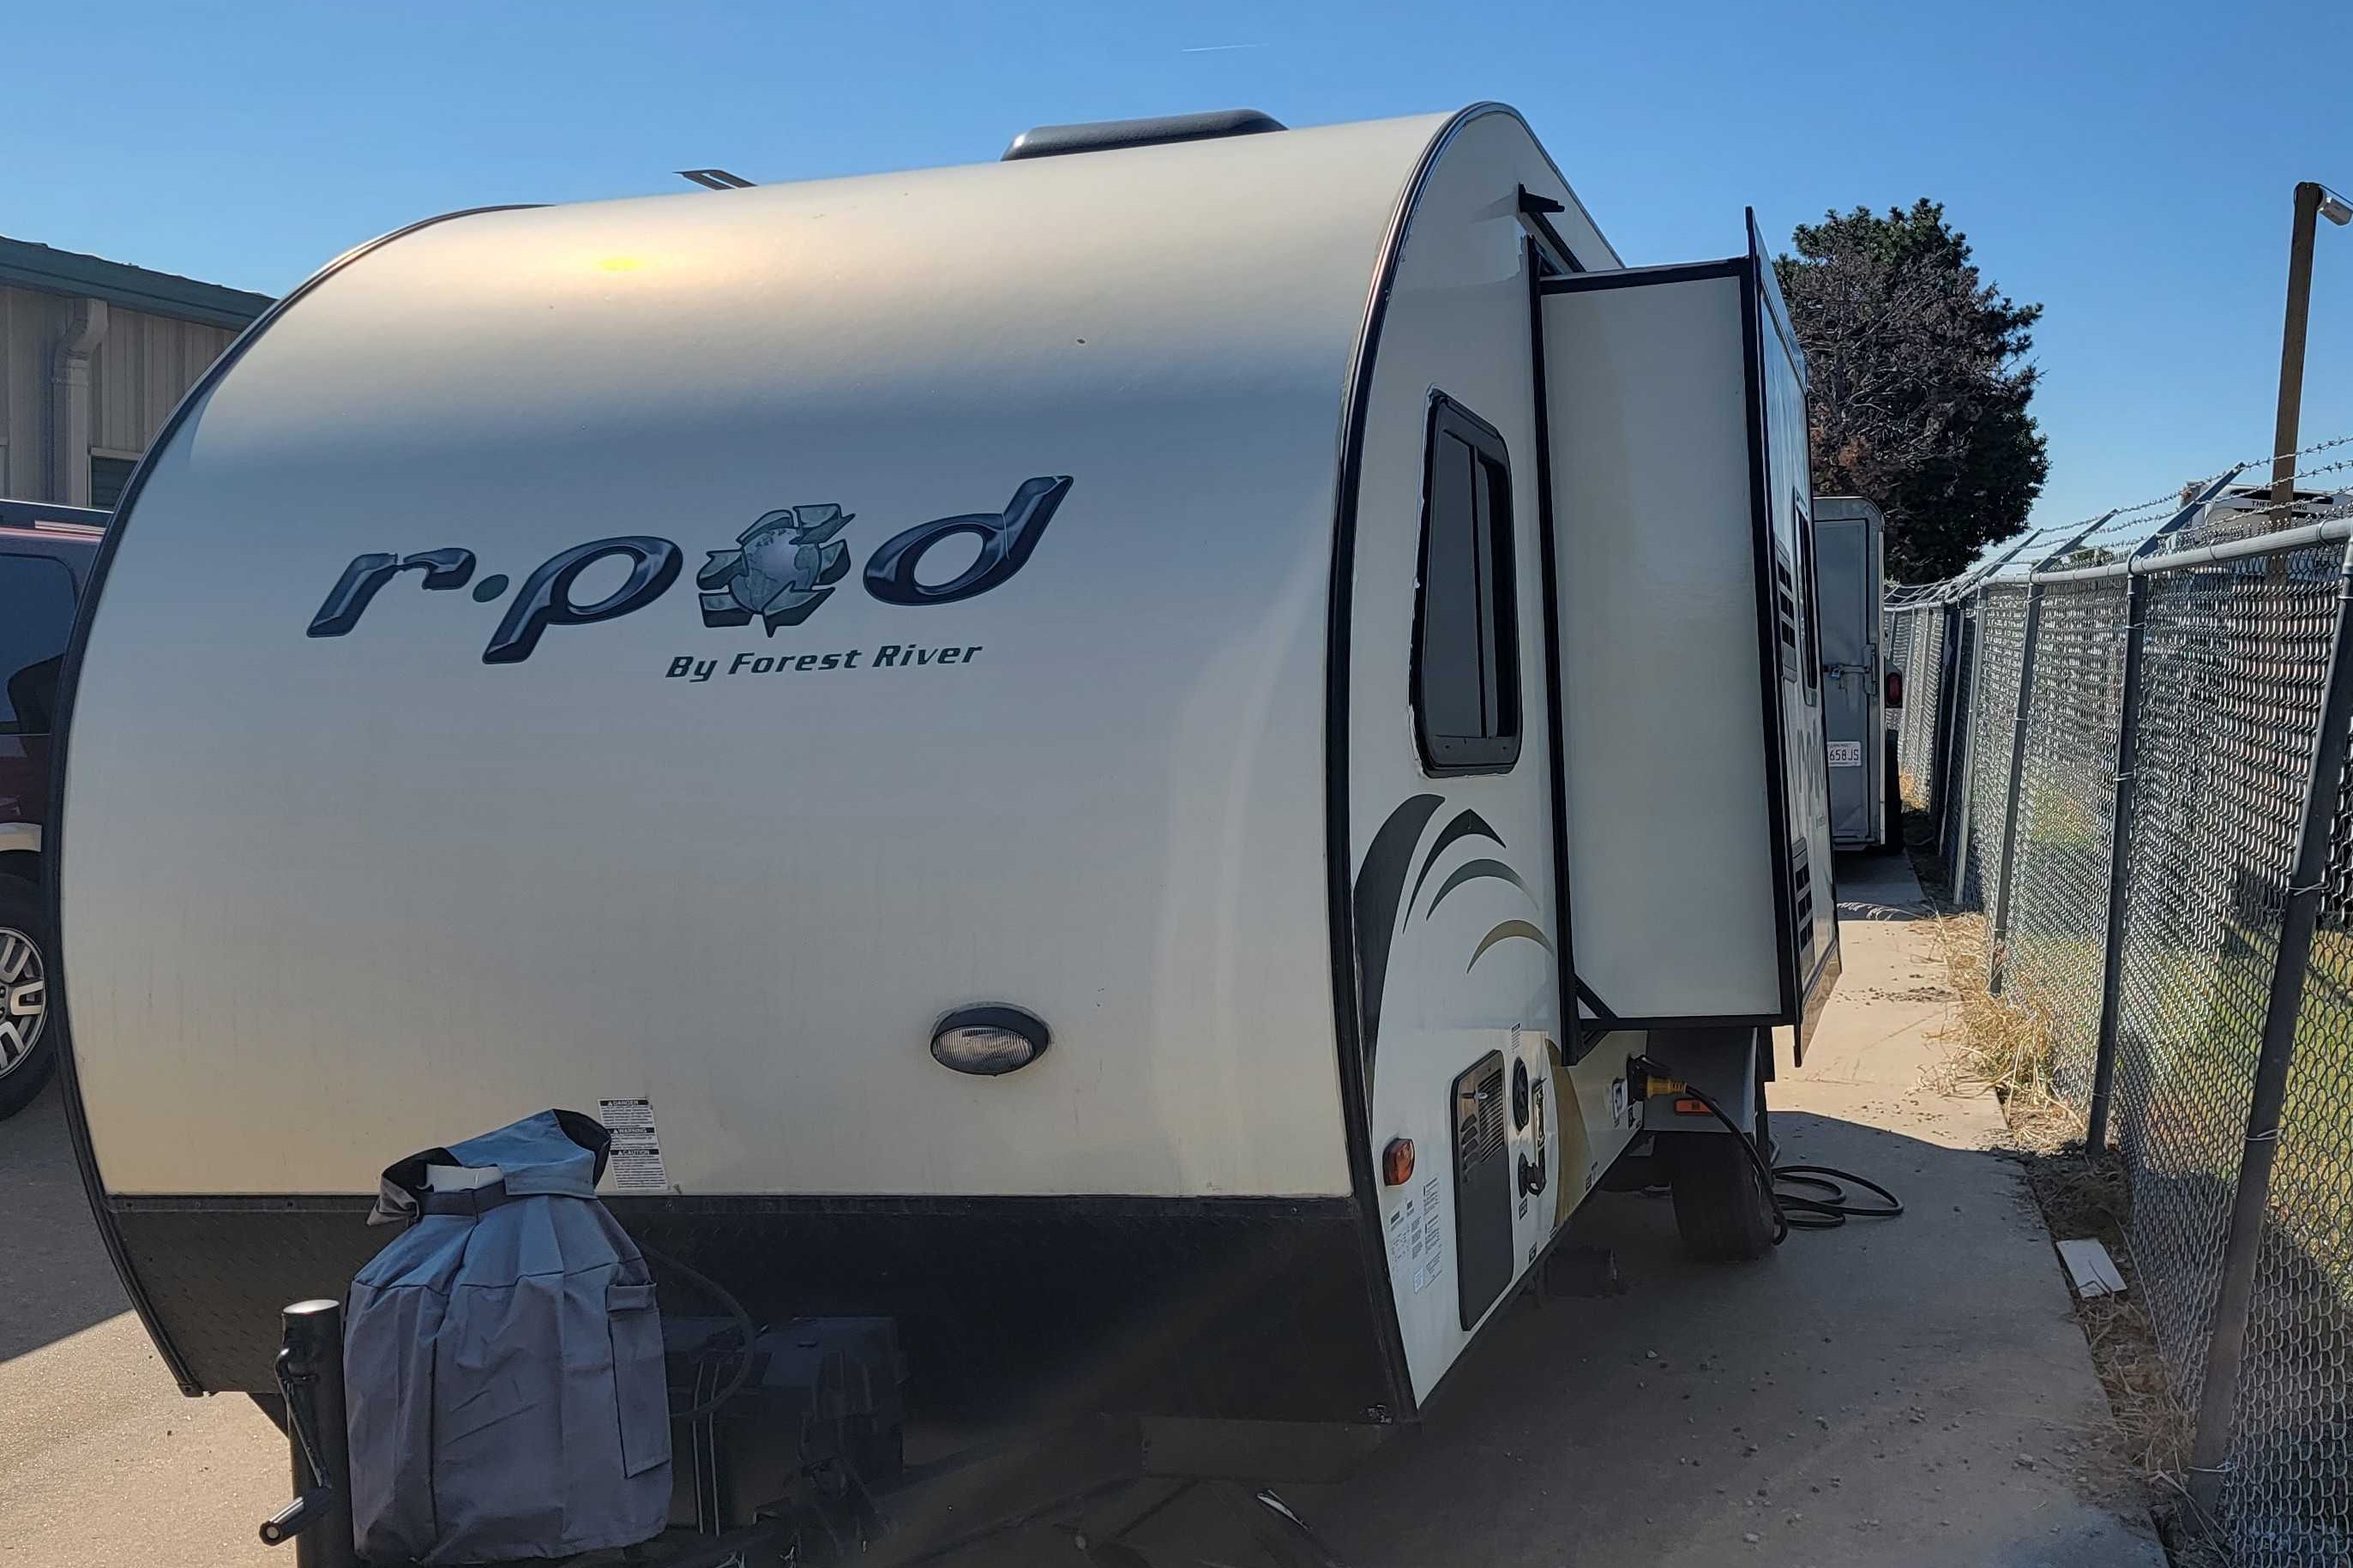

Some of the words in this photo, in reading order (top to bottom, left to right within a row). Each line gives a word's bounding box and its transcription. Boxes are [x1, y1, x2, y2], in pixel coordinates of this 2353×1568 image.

[665, 656, 718, 682] By
[727, 649, 862, 675] Forest
[871, 643, 983, 668] River
